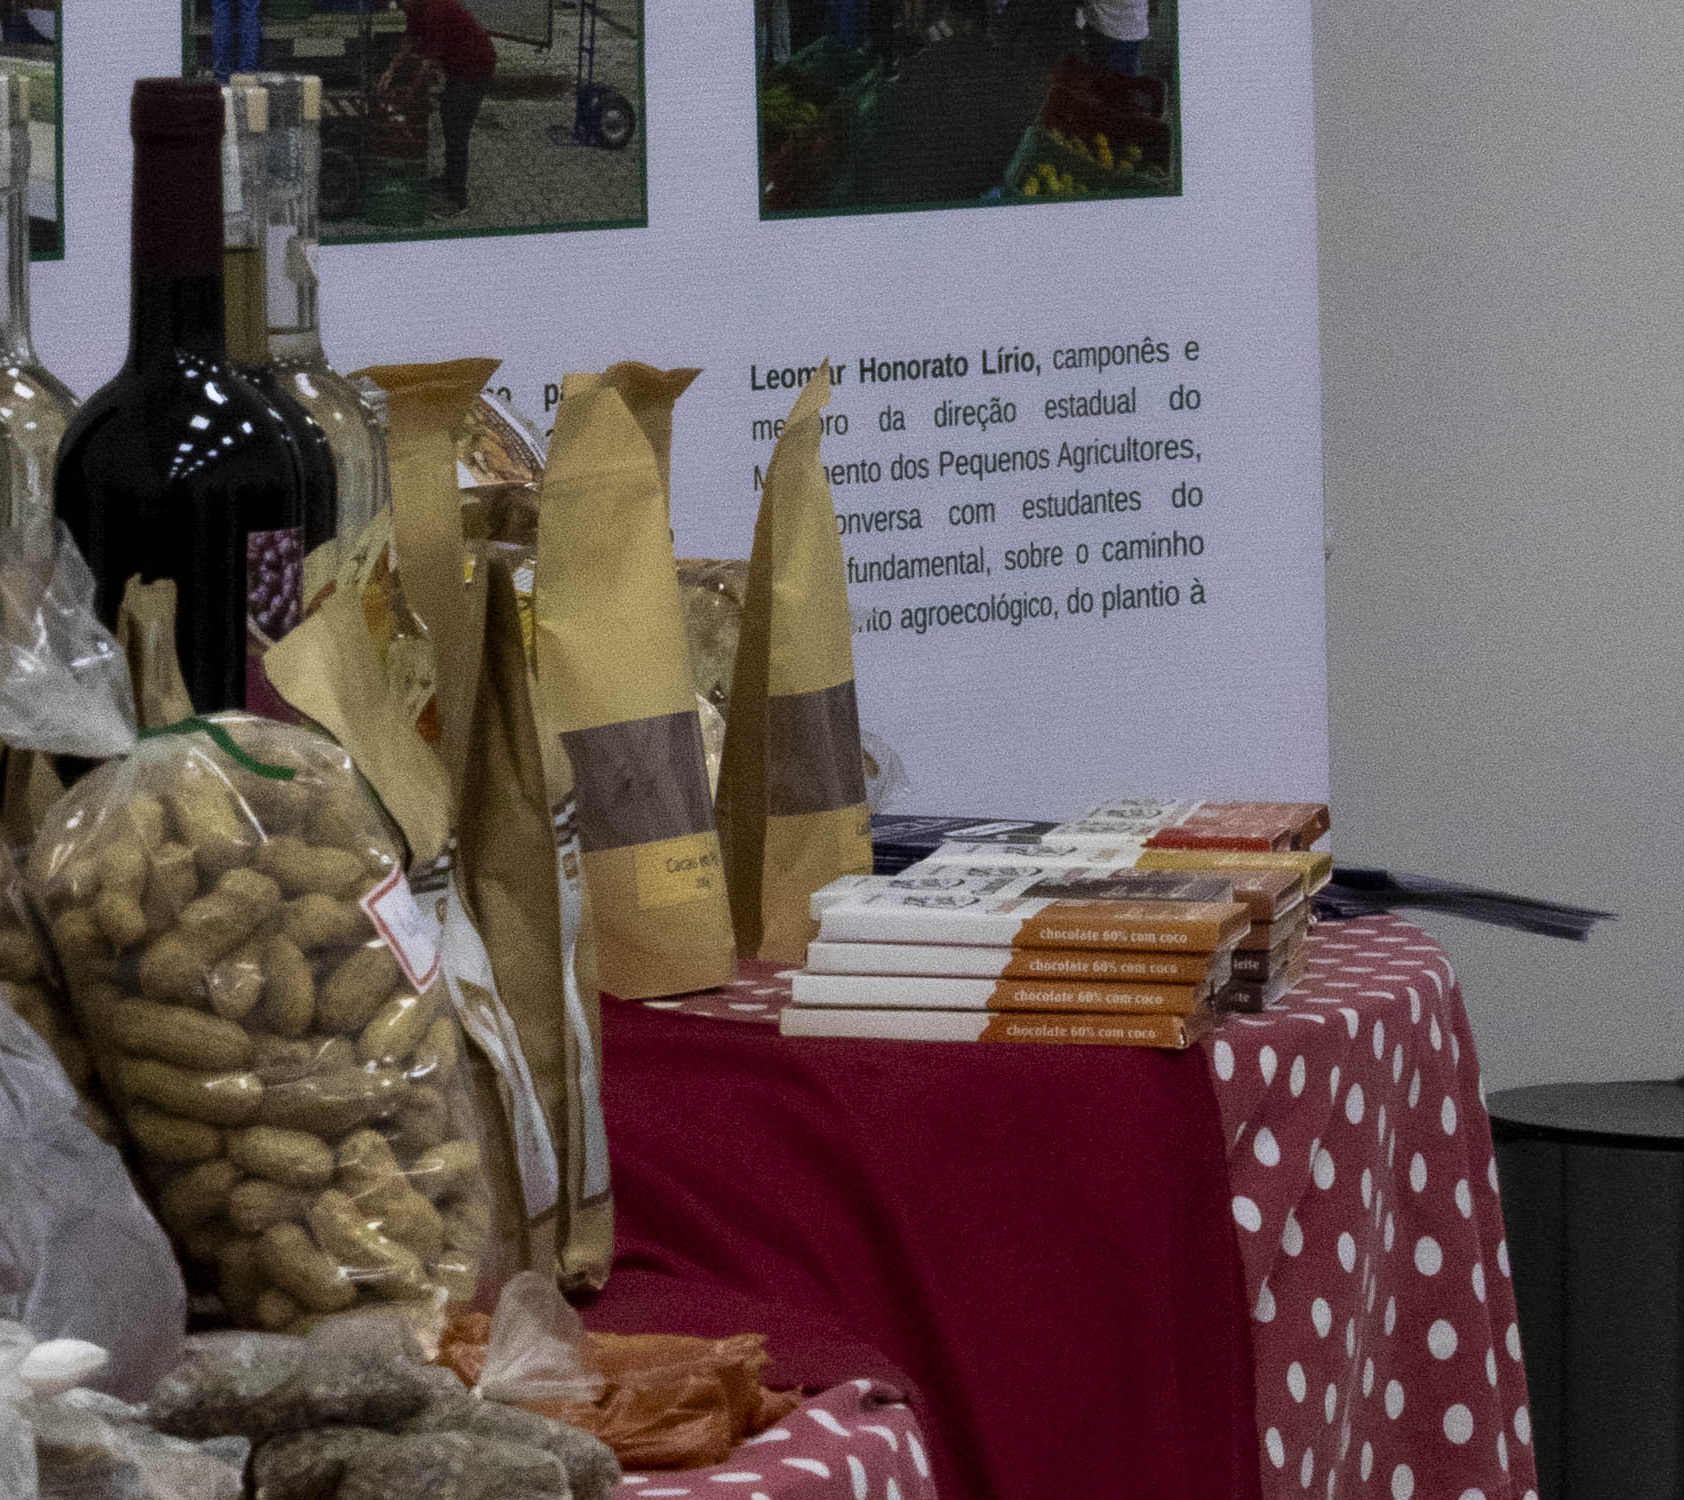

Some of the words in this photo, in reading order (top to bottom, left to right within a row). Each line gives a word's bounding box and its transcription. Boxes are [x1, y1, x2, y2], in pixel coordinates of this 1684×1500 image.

[858, 353, 970, 384] Honorato
[981, 346, 1042, 377] Lírio,
[1052, 336, 1170, 374] camponês
[1184, 340, 1200, 362] e
[878, 404, 907, 433] da
[933, 396, 1017, 432] direção
[1044, 386, 1136, 420] estadual
[1168, 383, 1201, 411] do
[890, 452, 930, 481] dos
[938, 447, 1051, 482] Pequenos
[1056, 435, 1202, 474] Agricultores,
[948, 501, 997, 527] com
[1022, 488, 1142, 521] estudantes
[1171, 480, 1204, 509] do
[846, 546, 992, 585] fundamental,
[1004, 541, 1064, 572] sobre
[1075, 543, 1090, 565] o
[1101, 530, 1205, 563] caminho
[899, 592, 1060, 635] agroecológico,
[1066, 586, 1094, 615] do
[1102, 580, 1180, 619] plantio
[1190, 577, 1207, 606] à
[1040, 927, 1100, 942] chocolate
[1103, 929, 1128, 943] 60%
[1130, 932, 1157, 944] com
[1160, 933, 1189, 945] coco
[1029, 959, 1089, 973] chocolate
[1092, 960, 1118, 974] 60%
[1120, 963, 1147, 975] com
[1150, 964, 1179, 975] coco
[1014, 989, 1074, 1003] chocolate
[1077, 991, 1102, 1004] 60%
[1105, 994, 1132, 1005] com
[1135, 995, 1164, 1006] coco
[1006, 1024, 1067, 1038] chocolate
[1070, 1026, 1096, 1039] 60%
[1098, 1028, 1125, 1040] com
[1128, 1029, 1157, 1040] coco
